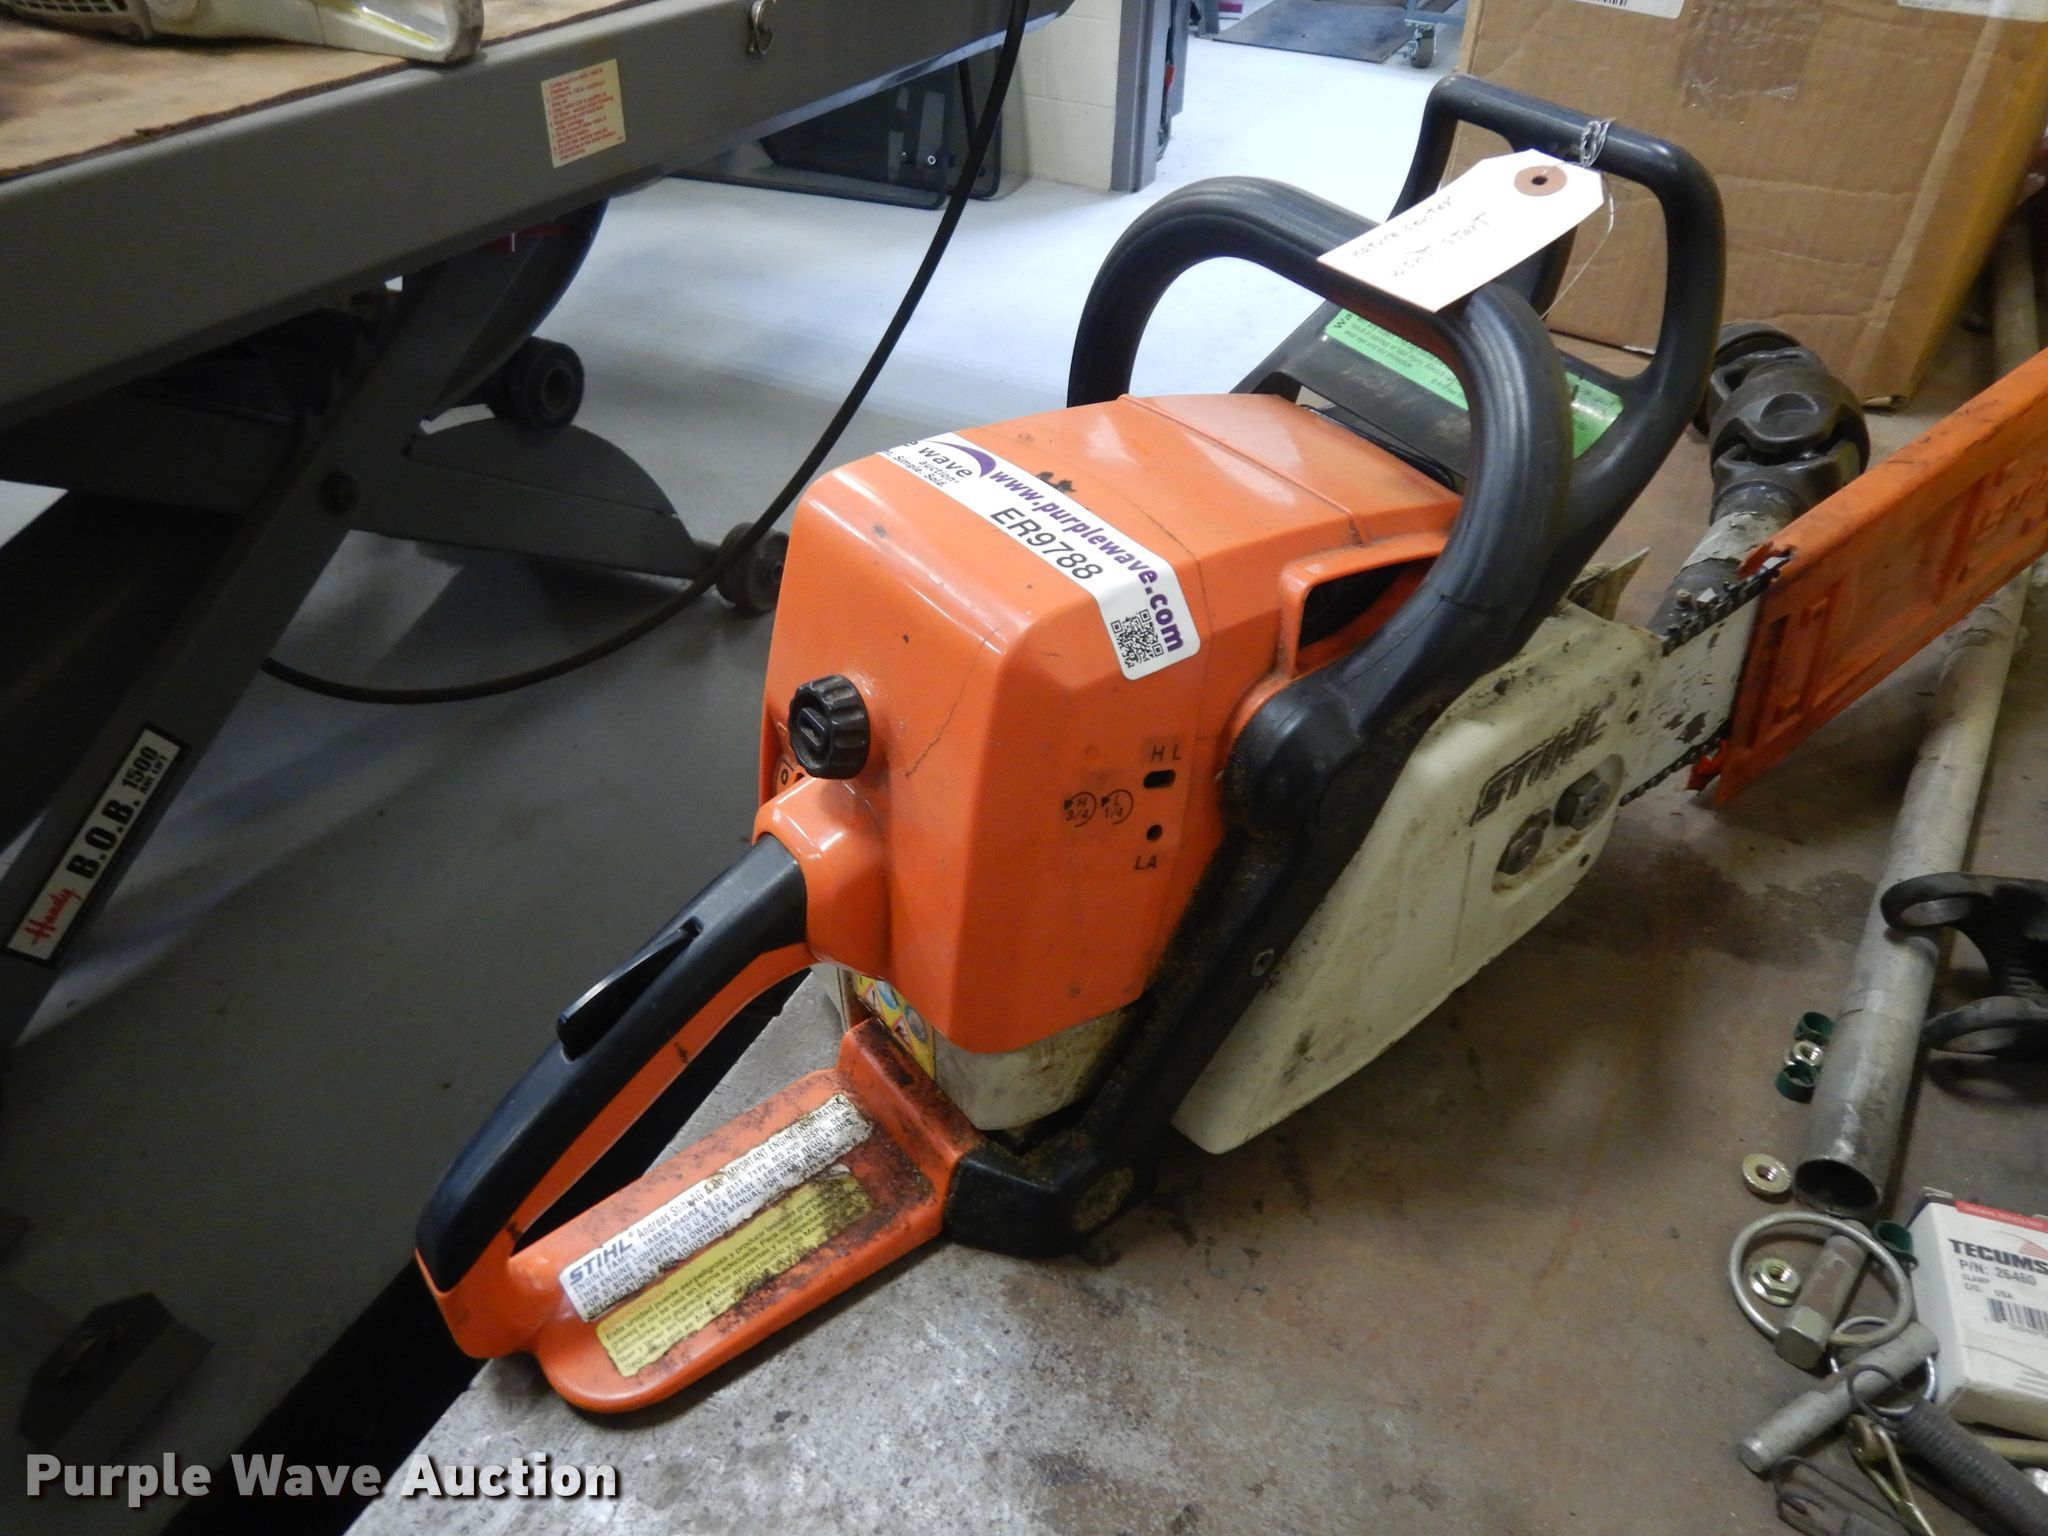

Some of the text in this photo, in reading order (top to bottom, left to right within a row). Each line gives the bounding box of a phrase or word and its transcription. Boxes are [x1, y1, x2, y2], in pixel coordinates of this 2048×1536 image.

[918, 447, 973, 477] wave
[989, 471, 1184, 653] www.purplewave.com
[990, 507, 1103, 580] ER9788
[122, 745, 158, 789] 1500
[1152, 744, 1182, 761] H L
[66, 799, 140, 880] B.O.B.
[1135, 855, 1157, 870] LA
[770, 1151, 785, 1163] MS
[569, 1240, 633, 1284] STIHL
[634, 1210, 671, 1239] Andreas
[689, 1189, 705, 1203] AG
[722, 1146, 770, 1181] IMPORTANT
[766, 1129, 797, 1152] ENGINE
[576, 1283, 600, 1302] THIS
[598, 1262, 632, 1288] ENGINE
[632, 1230, 680, 1266] CONFORMS
[679, 1222, 693, 1234] TO
[710, 1198, 729, 1214] EPA
[727, 1181, 755, 1202] PHASE
[762, 1151, 801, 1180] EMISSION
[581, 1293, 602, 1311] FOR
[647, 1244, 676, 1267] REFER
[676, 1235, 689, 1247] TO
[726, 1187, 762, 1214] MANUAL
[761, 1175, 780, 1190] FOR
